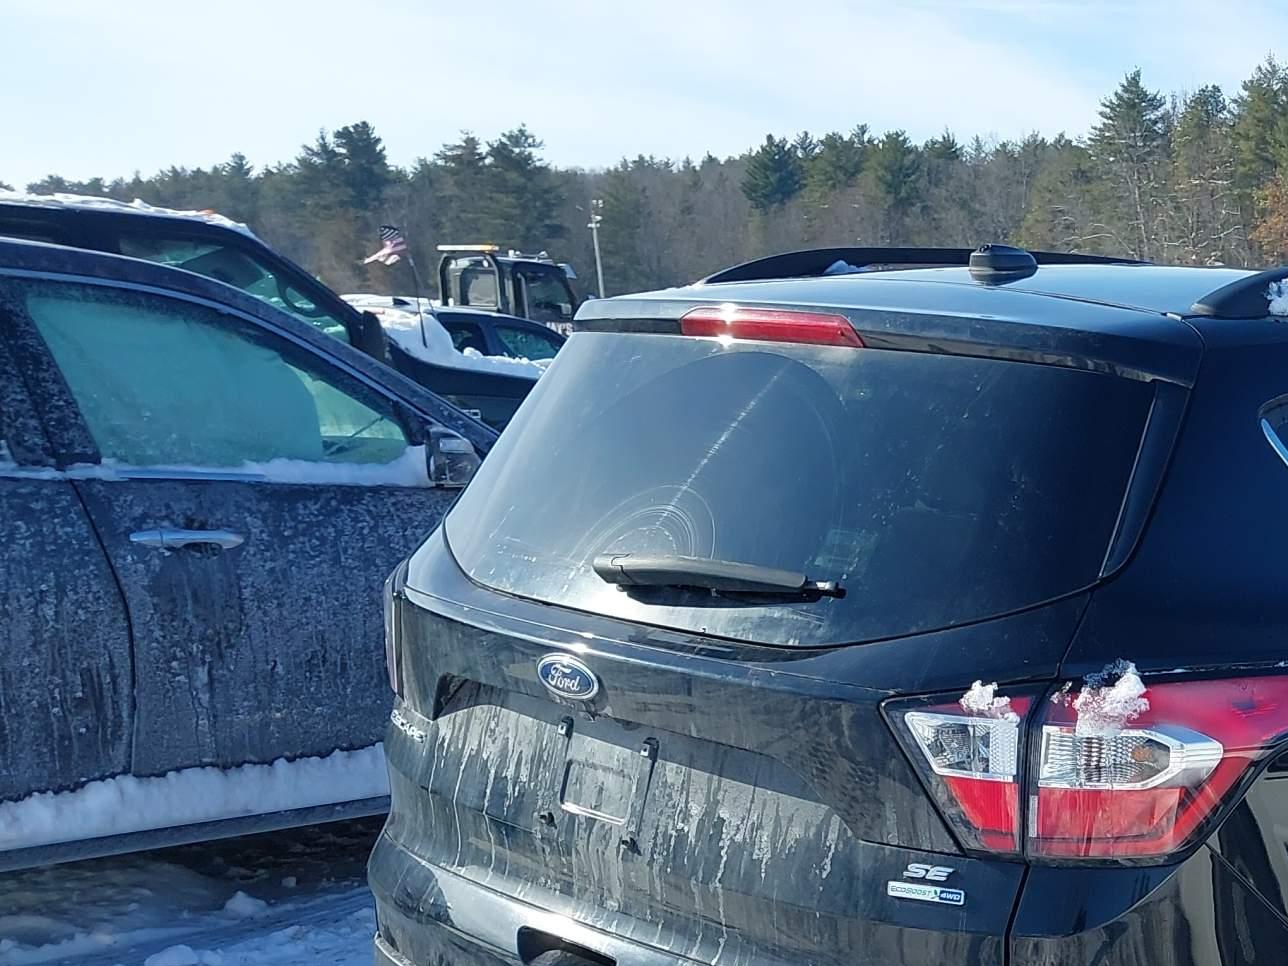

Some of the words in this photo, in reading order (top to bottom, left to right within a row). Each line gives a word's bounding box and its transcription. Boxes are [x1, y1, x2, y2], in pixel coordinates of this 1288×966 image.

[547, 663, 581, 691] Ford
[902, 862, 955, 882] SE
[940, 891, 961, 901] 4WD
